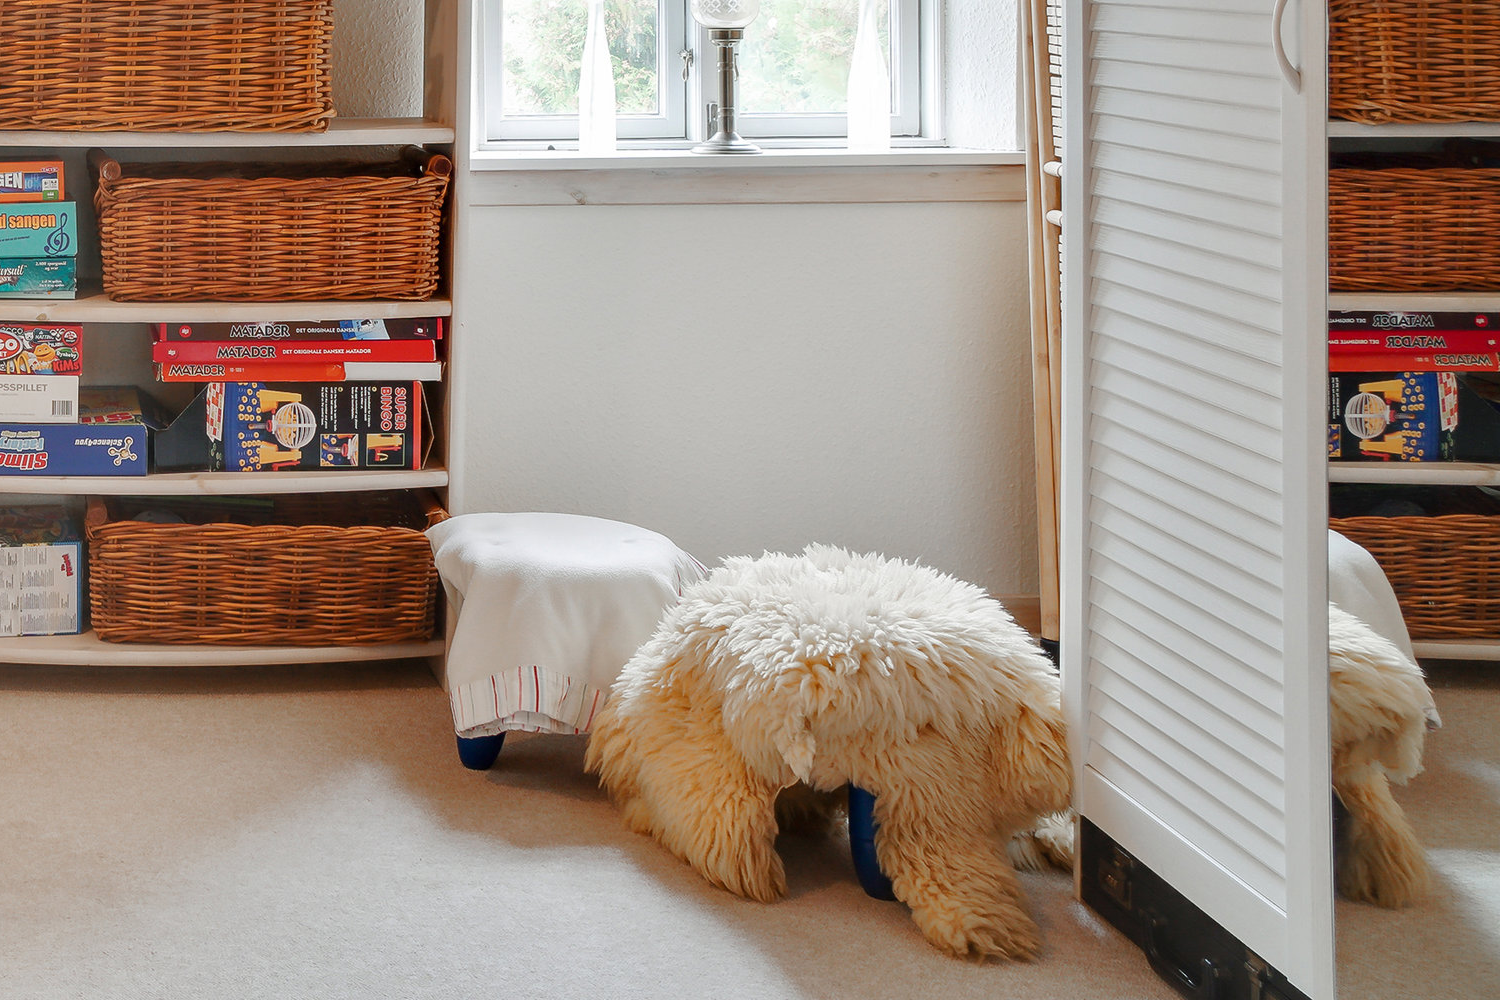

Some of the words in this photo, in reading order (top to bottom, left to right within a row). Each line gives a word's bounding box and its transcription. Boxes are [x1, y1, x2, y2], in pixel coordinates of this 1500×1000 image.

[8, 213, 56, 230] sangen
[230, 325, 290, 339] MATADOR
[217, 346, 276, 359] MATADOR
[169, 362, 225, 377] MATADOR
[380, 386, 393, 431] BINGO
[394, 387, 407, 431] SUPER
[74, 437, 123, 447] Science4you
